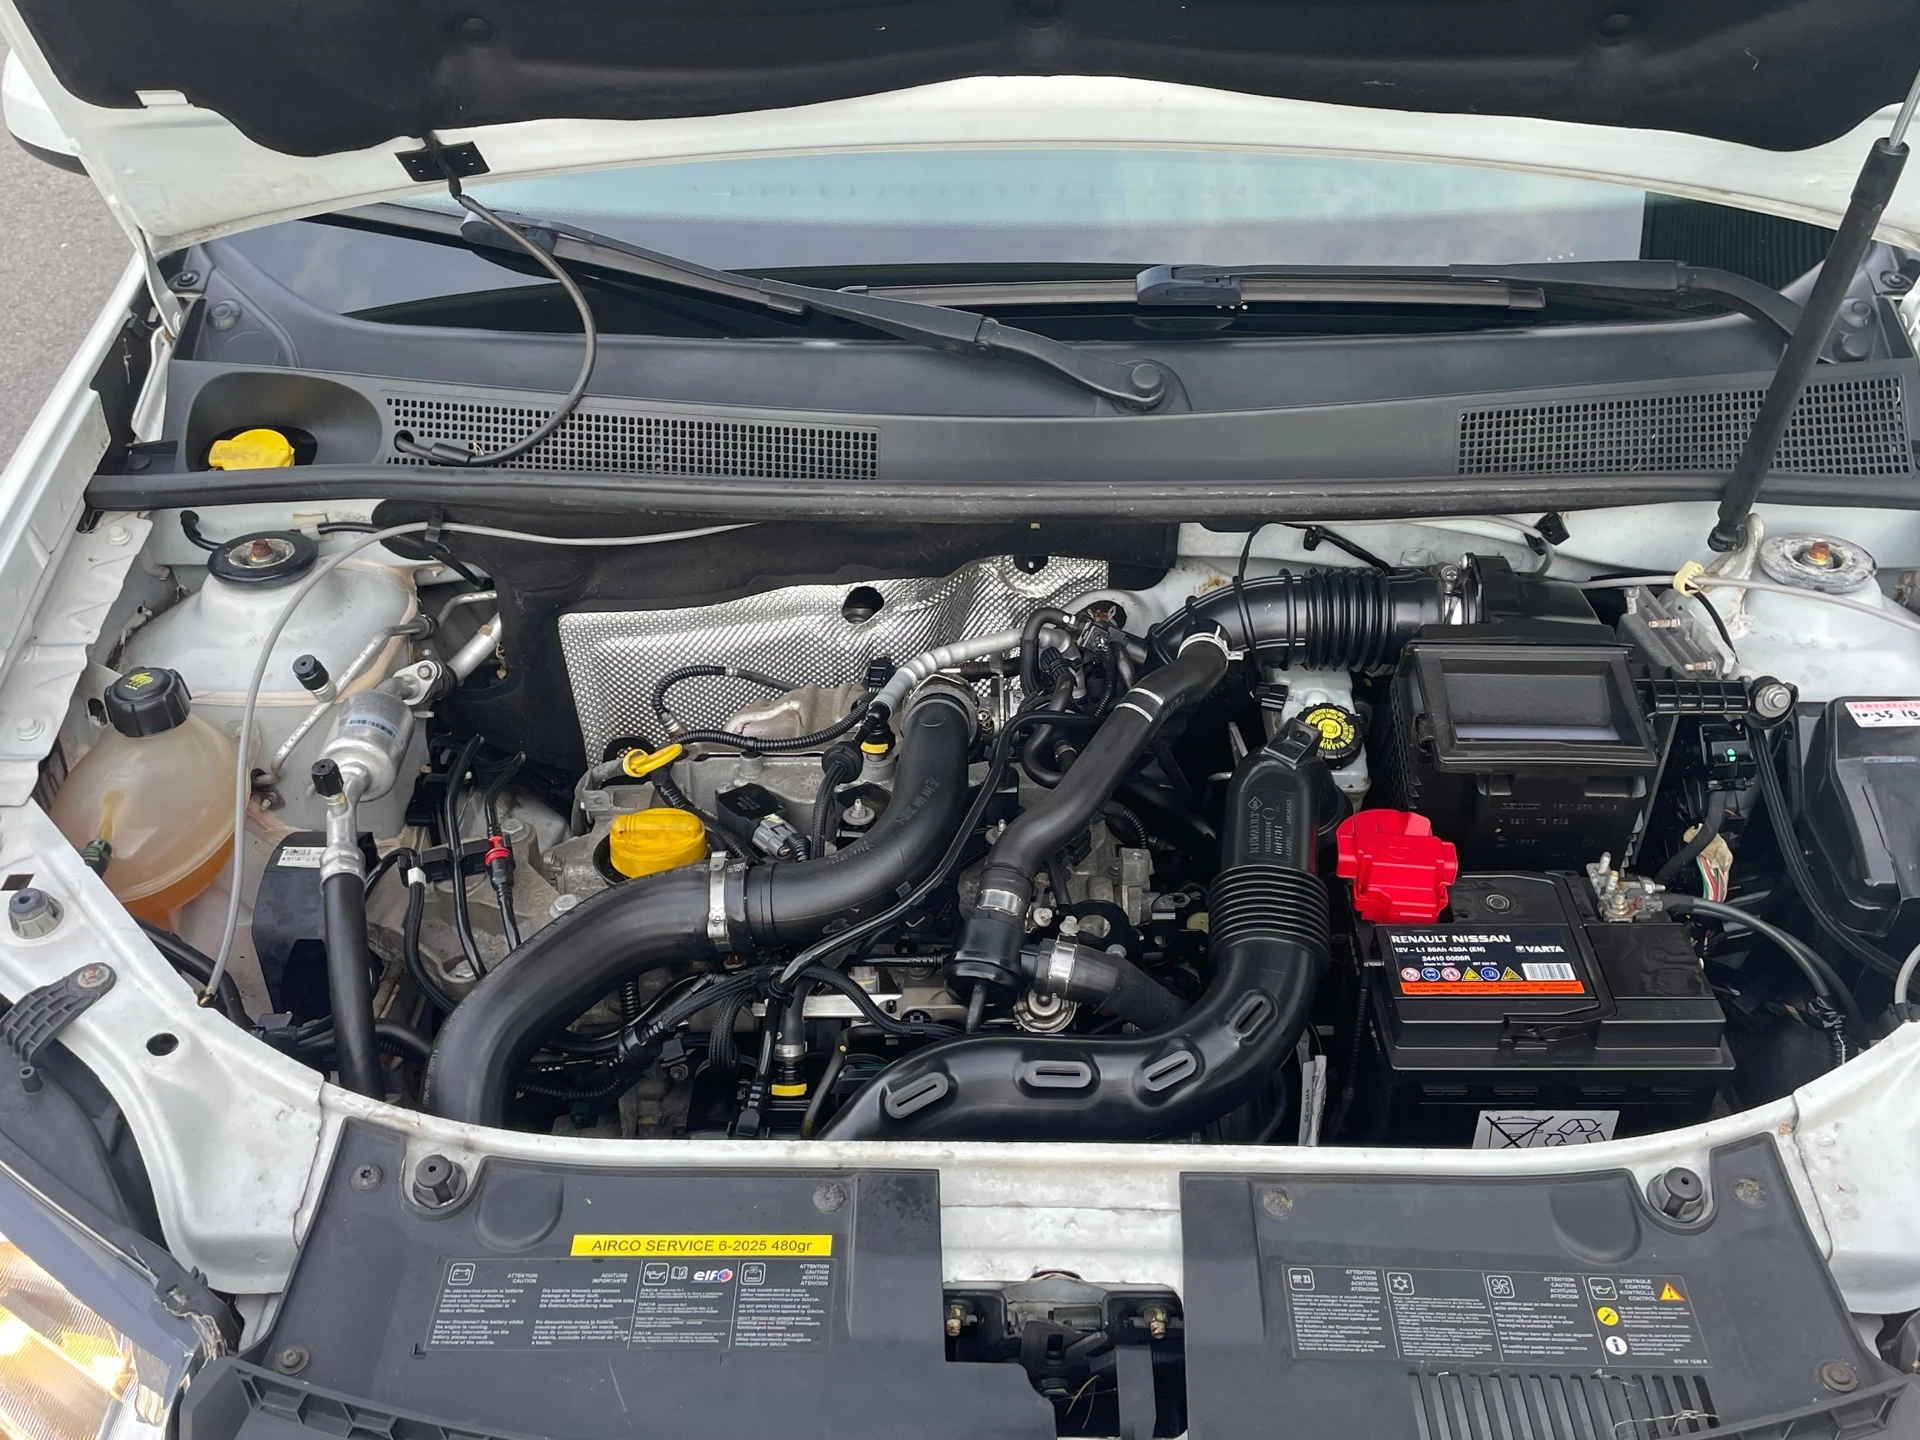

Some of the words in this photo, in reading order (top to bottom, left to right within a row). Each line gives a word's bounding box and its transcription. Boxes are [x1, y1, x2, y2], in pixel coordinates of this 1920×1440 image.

[591, 1240, 641, 1252] AIRCO
[646, 1240, 714, 1252] SERVICE
[718, 1240, 767, 1252] 6-2025
[771, 1240, 812, 1253] 480gr
[693, 1270, 718, 1280] elf
